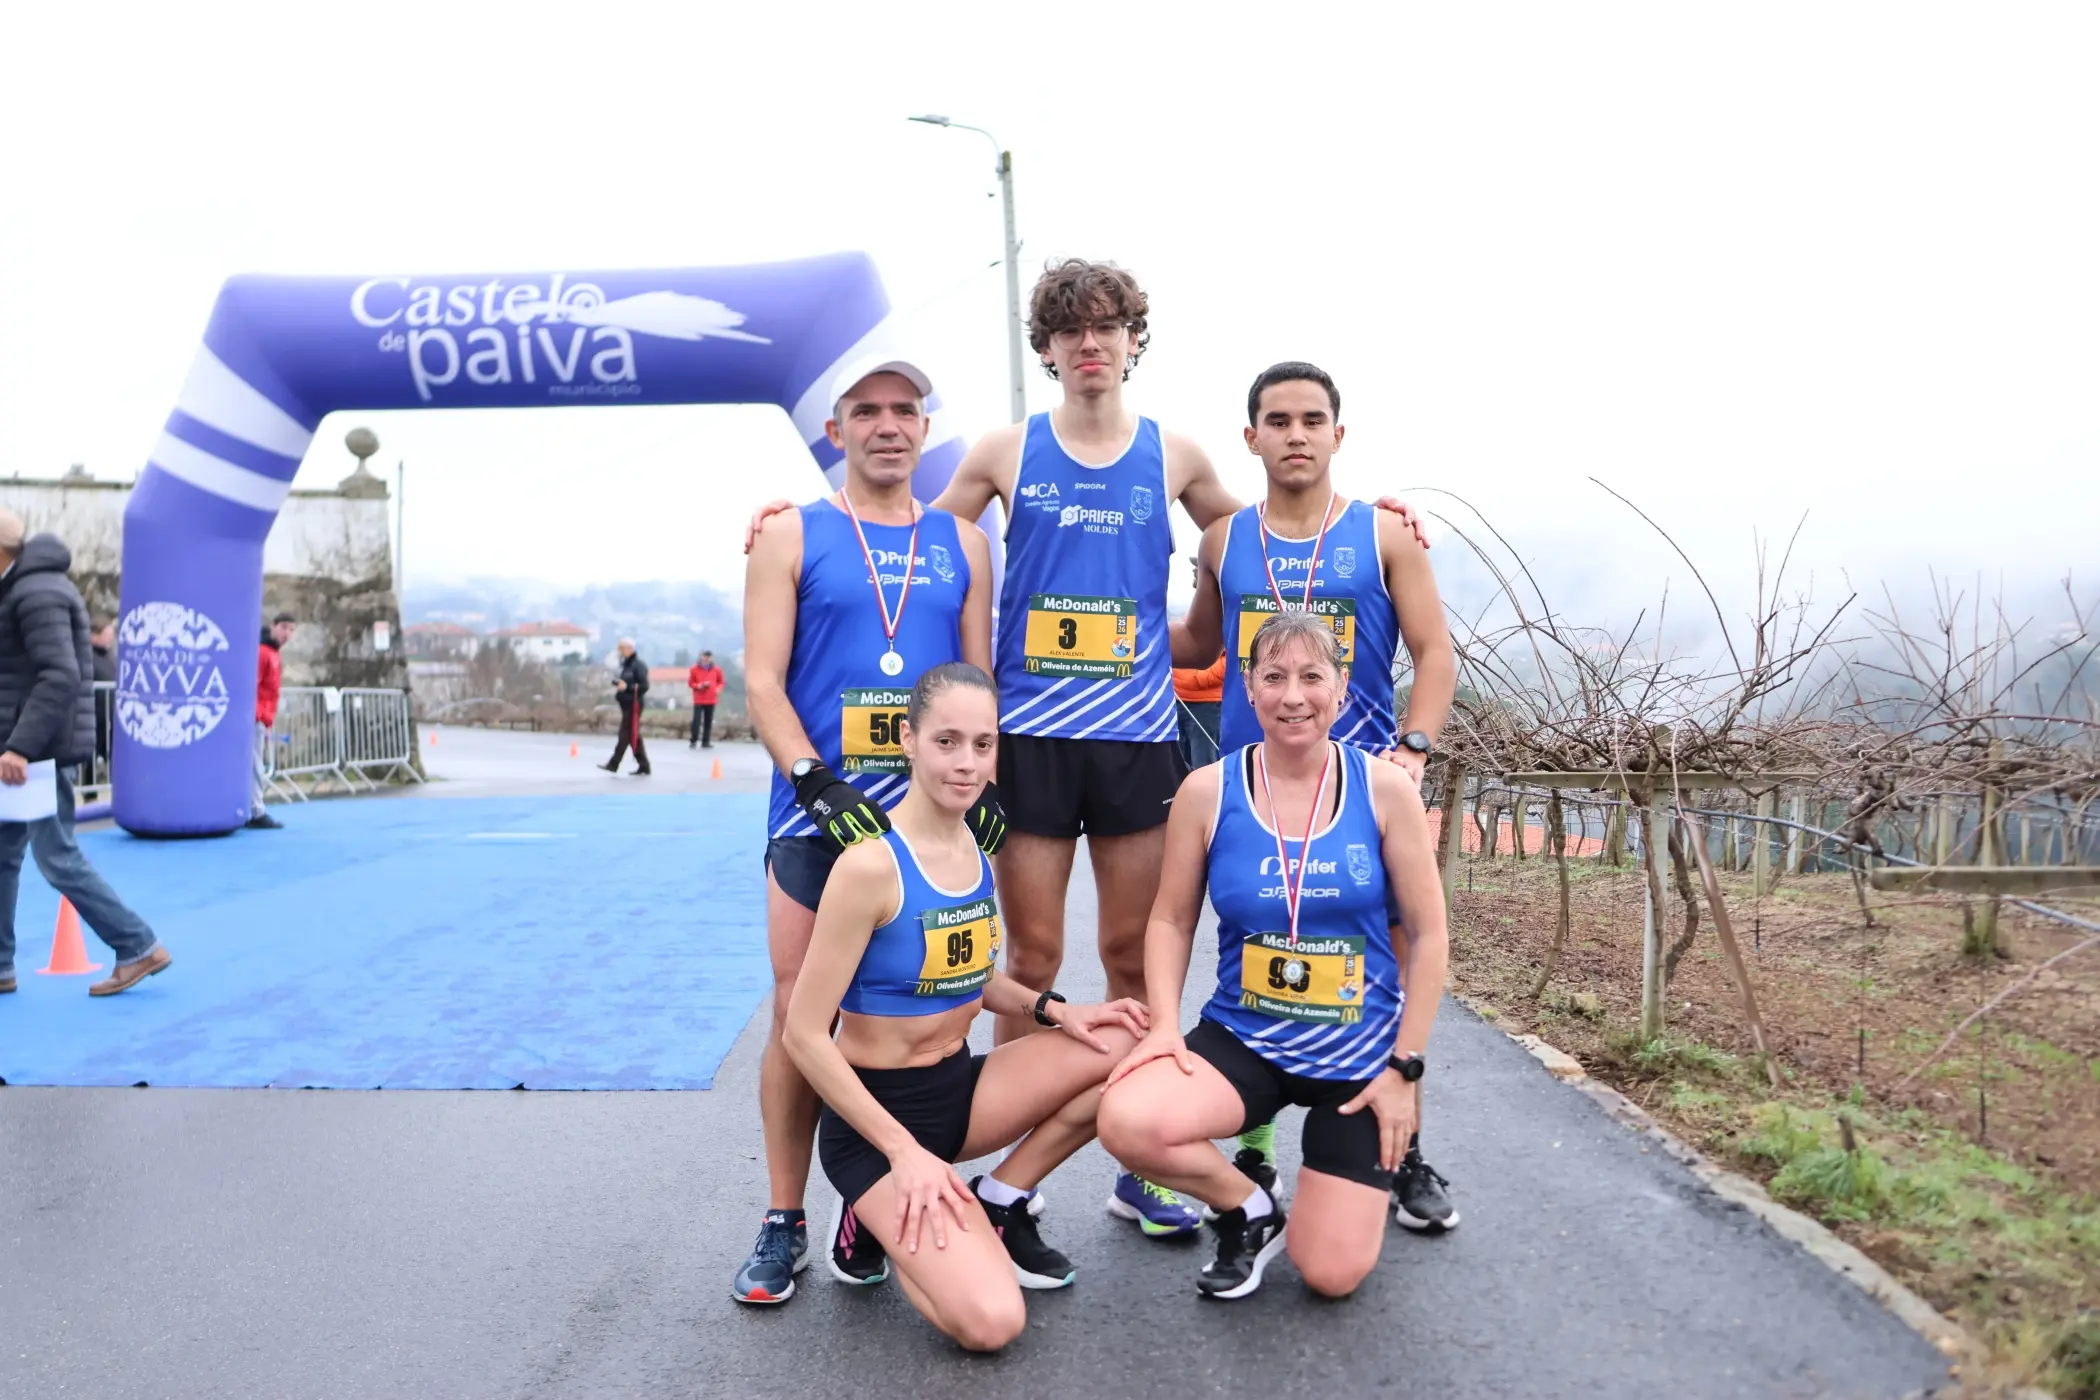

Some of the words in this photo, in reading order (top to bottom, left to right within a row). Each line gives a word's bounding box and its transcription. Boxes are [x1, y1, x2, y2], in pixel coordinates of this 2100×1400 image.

[350, 272, 606, 328] Castelo
[378, 330, 405, 353] de
[406, 321, 637, 402] paiva
[1037, 482, 1060, 498] CA
[1080, 508, 1124, 526] PRIFER
[1083, 524, 1119, 535] MOLDES
[1043, 597, 1121, 613] McDonald's
[1334, 619, 1344, 627] 25
[1058, 618, 1077, 650] 3
[1041, 661, 1071, 671] Oliveira
[1071, 663, 1082, 672] de
[1082, 664, 1115, 673] Azeméis
[119, 660, 228, 696] PAYVA
[863, 759, 896, 768] Oliveira
[1288, 858, 1337, 875] Pifer
[937, 902, 990, 926] McDonald's
[946, 928, 974, 968] 95
[936, 980, 963, 990] Oliveira
[963, 978, 970, 987] de
[1258, 998, 1291, 1013] Oliveira
[1291, 1005, 1303, 1014] de
